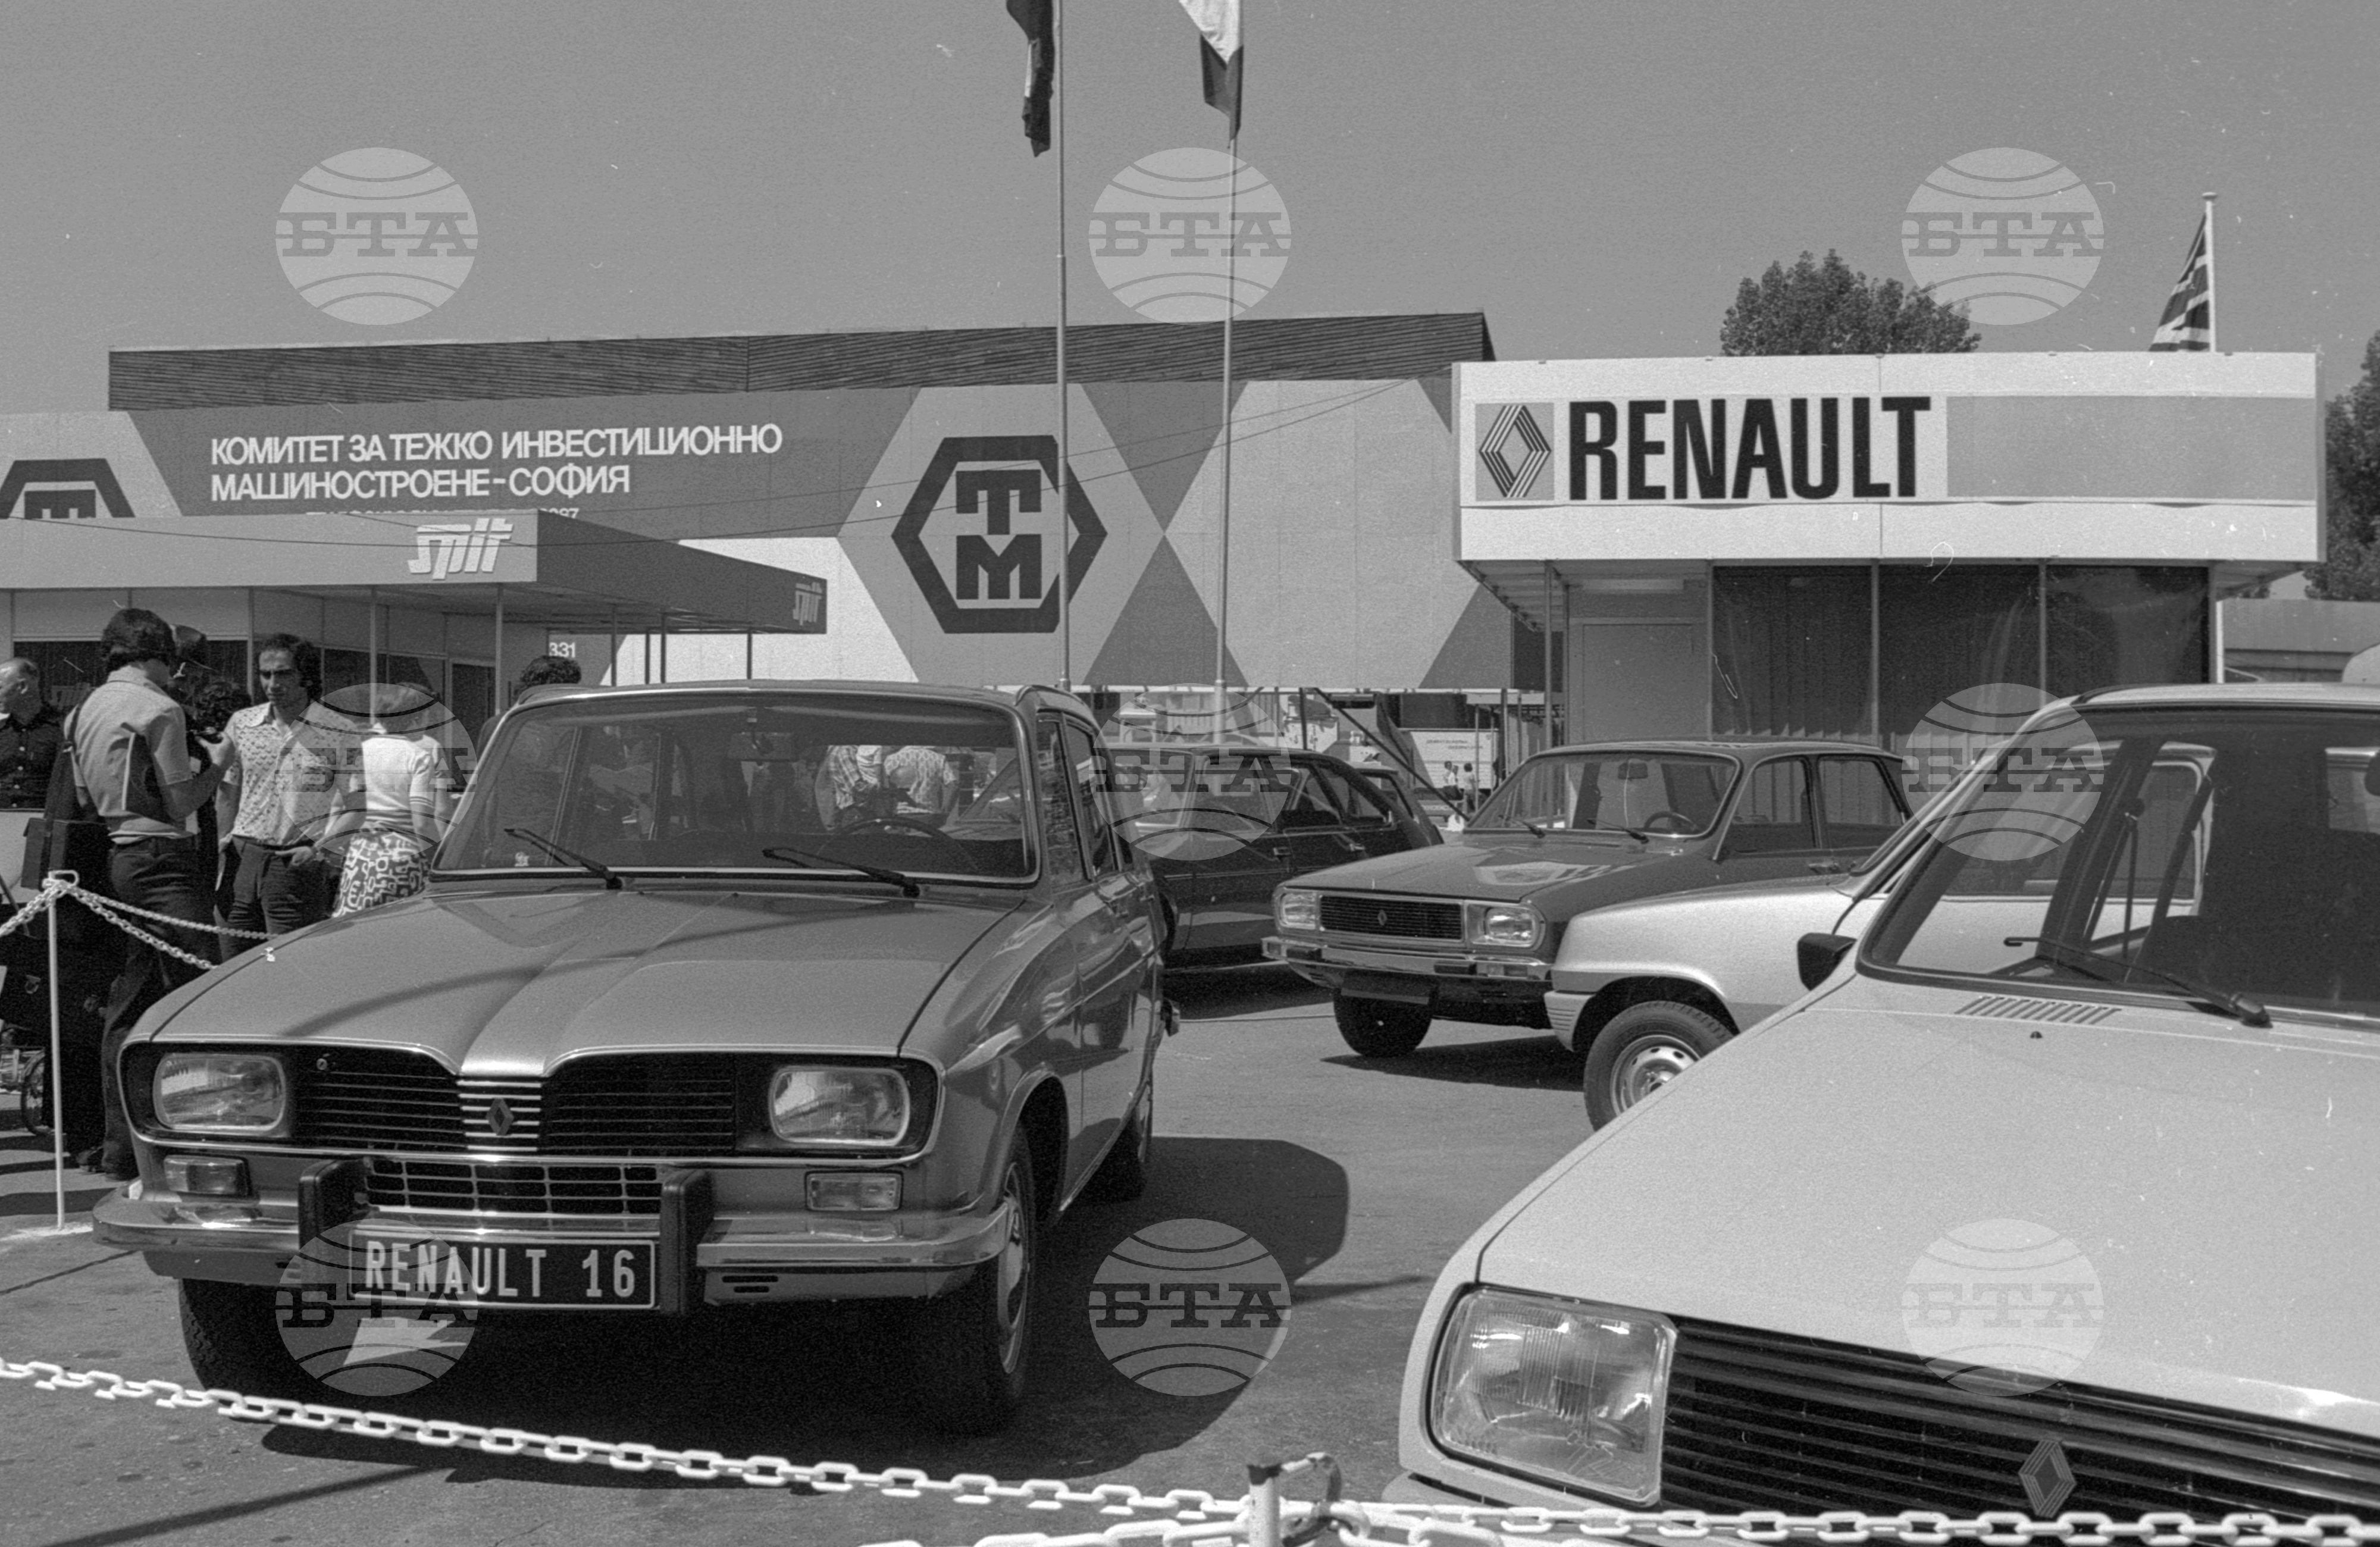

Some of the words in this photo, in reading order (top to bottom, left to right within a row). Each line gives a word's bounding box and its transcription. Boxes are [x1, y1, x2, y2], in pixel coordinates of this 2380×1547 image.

[211, 436, 344, 465] КОМИТЕТ
[349, 434, 386, 462] ЗА
[389, 430, 493, 461] ТЕЖКО
[502, 423, 782, 459] ИНВЕСТИЦИОННО
[1569, 396, 1931, 500] RENAULT
[549, 641, 575, 658] 331
[365, 1241, 547, 1298] RENAULT
[583, 1248, 635, 1298] 16
